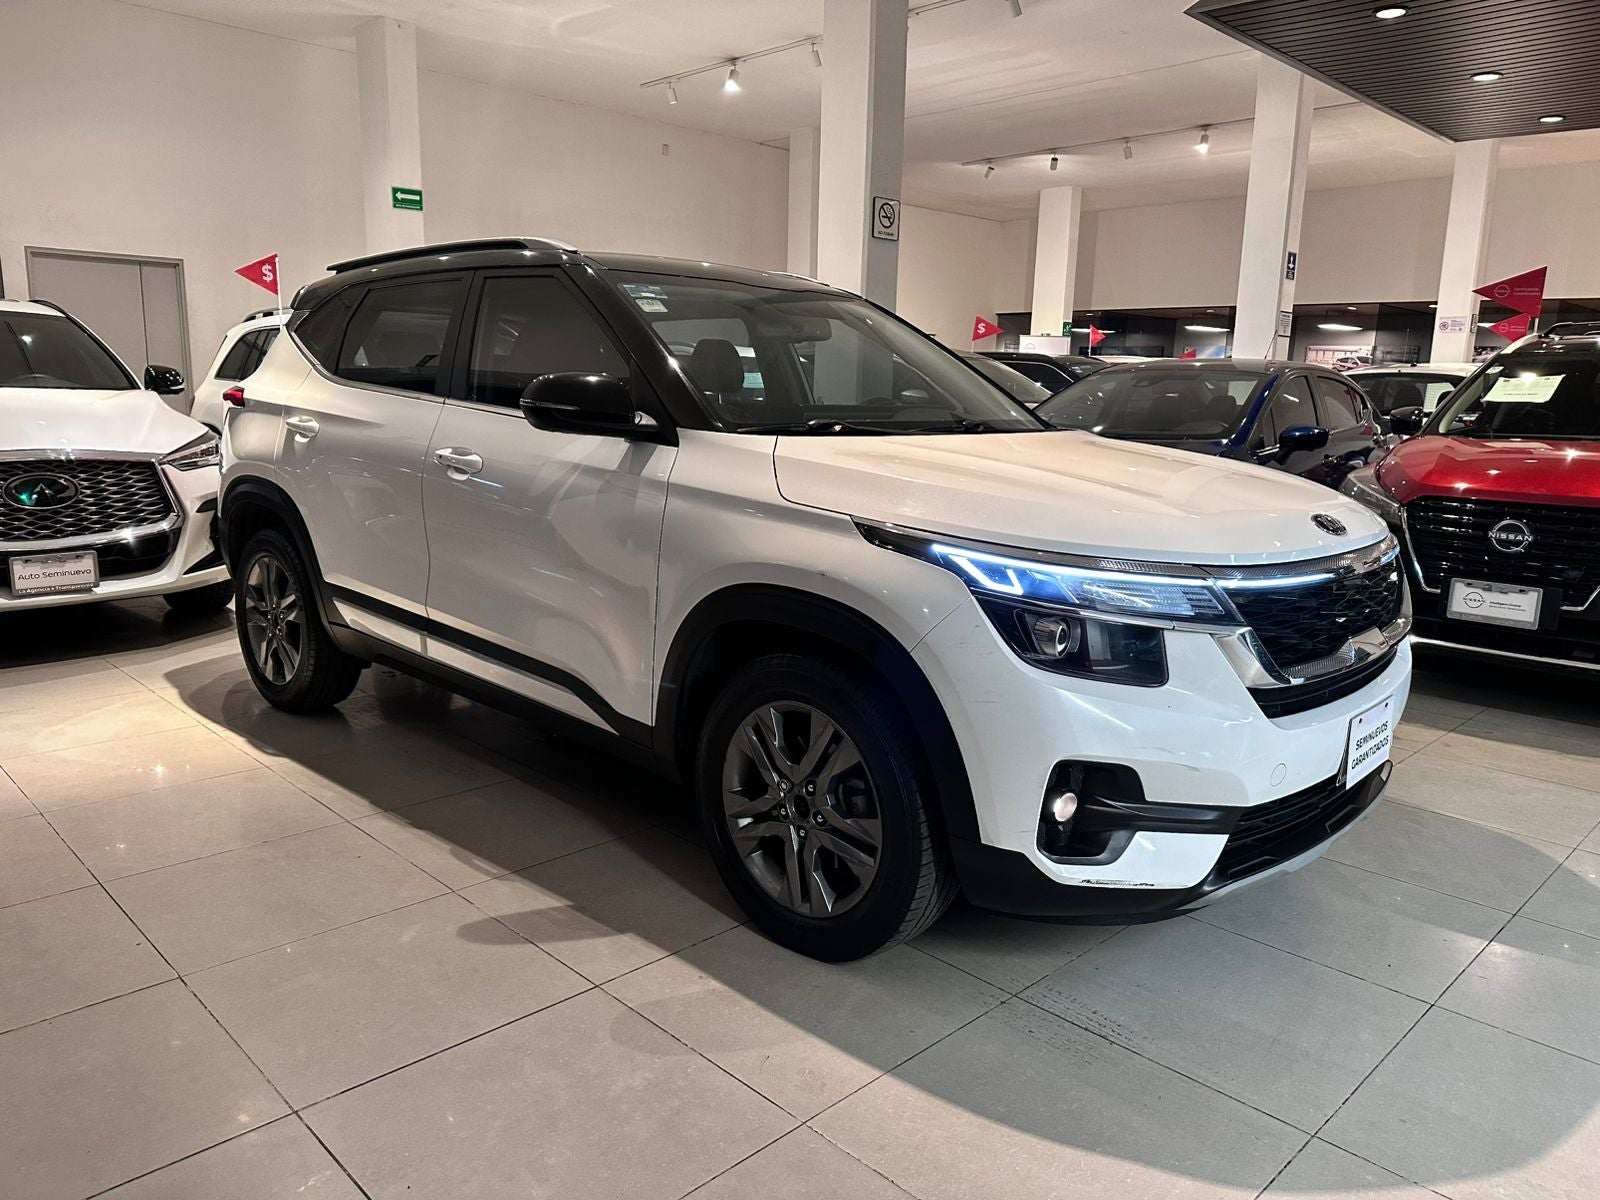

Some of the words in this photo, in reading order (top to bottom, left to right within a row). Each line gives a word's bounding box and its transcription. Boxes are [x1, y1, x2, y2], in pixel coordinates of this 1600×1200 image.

[261, 263, 273, 283] $
[977, 322, 986, 335] $
[1488, 531, 1533, 541] NISSAN
[42, 568, 92, 578] Seminuevo
[1356, 720, 1388, 751] SEMINUEVOS
[1352, 735, 1389, 770] GARANTIZADOS
